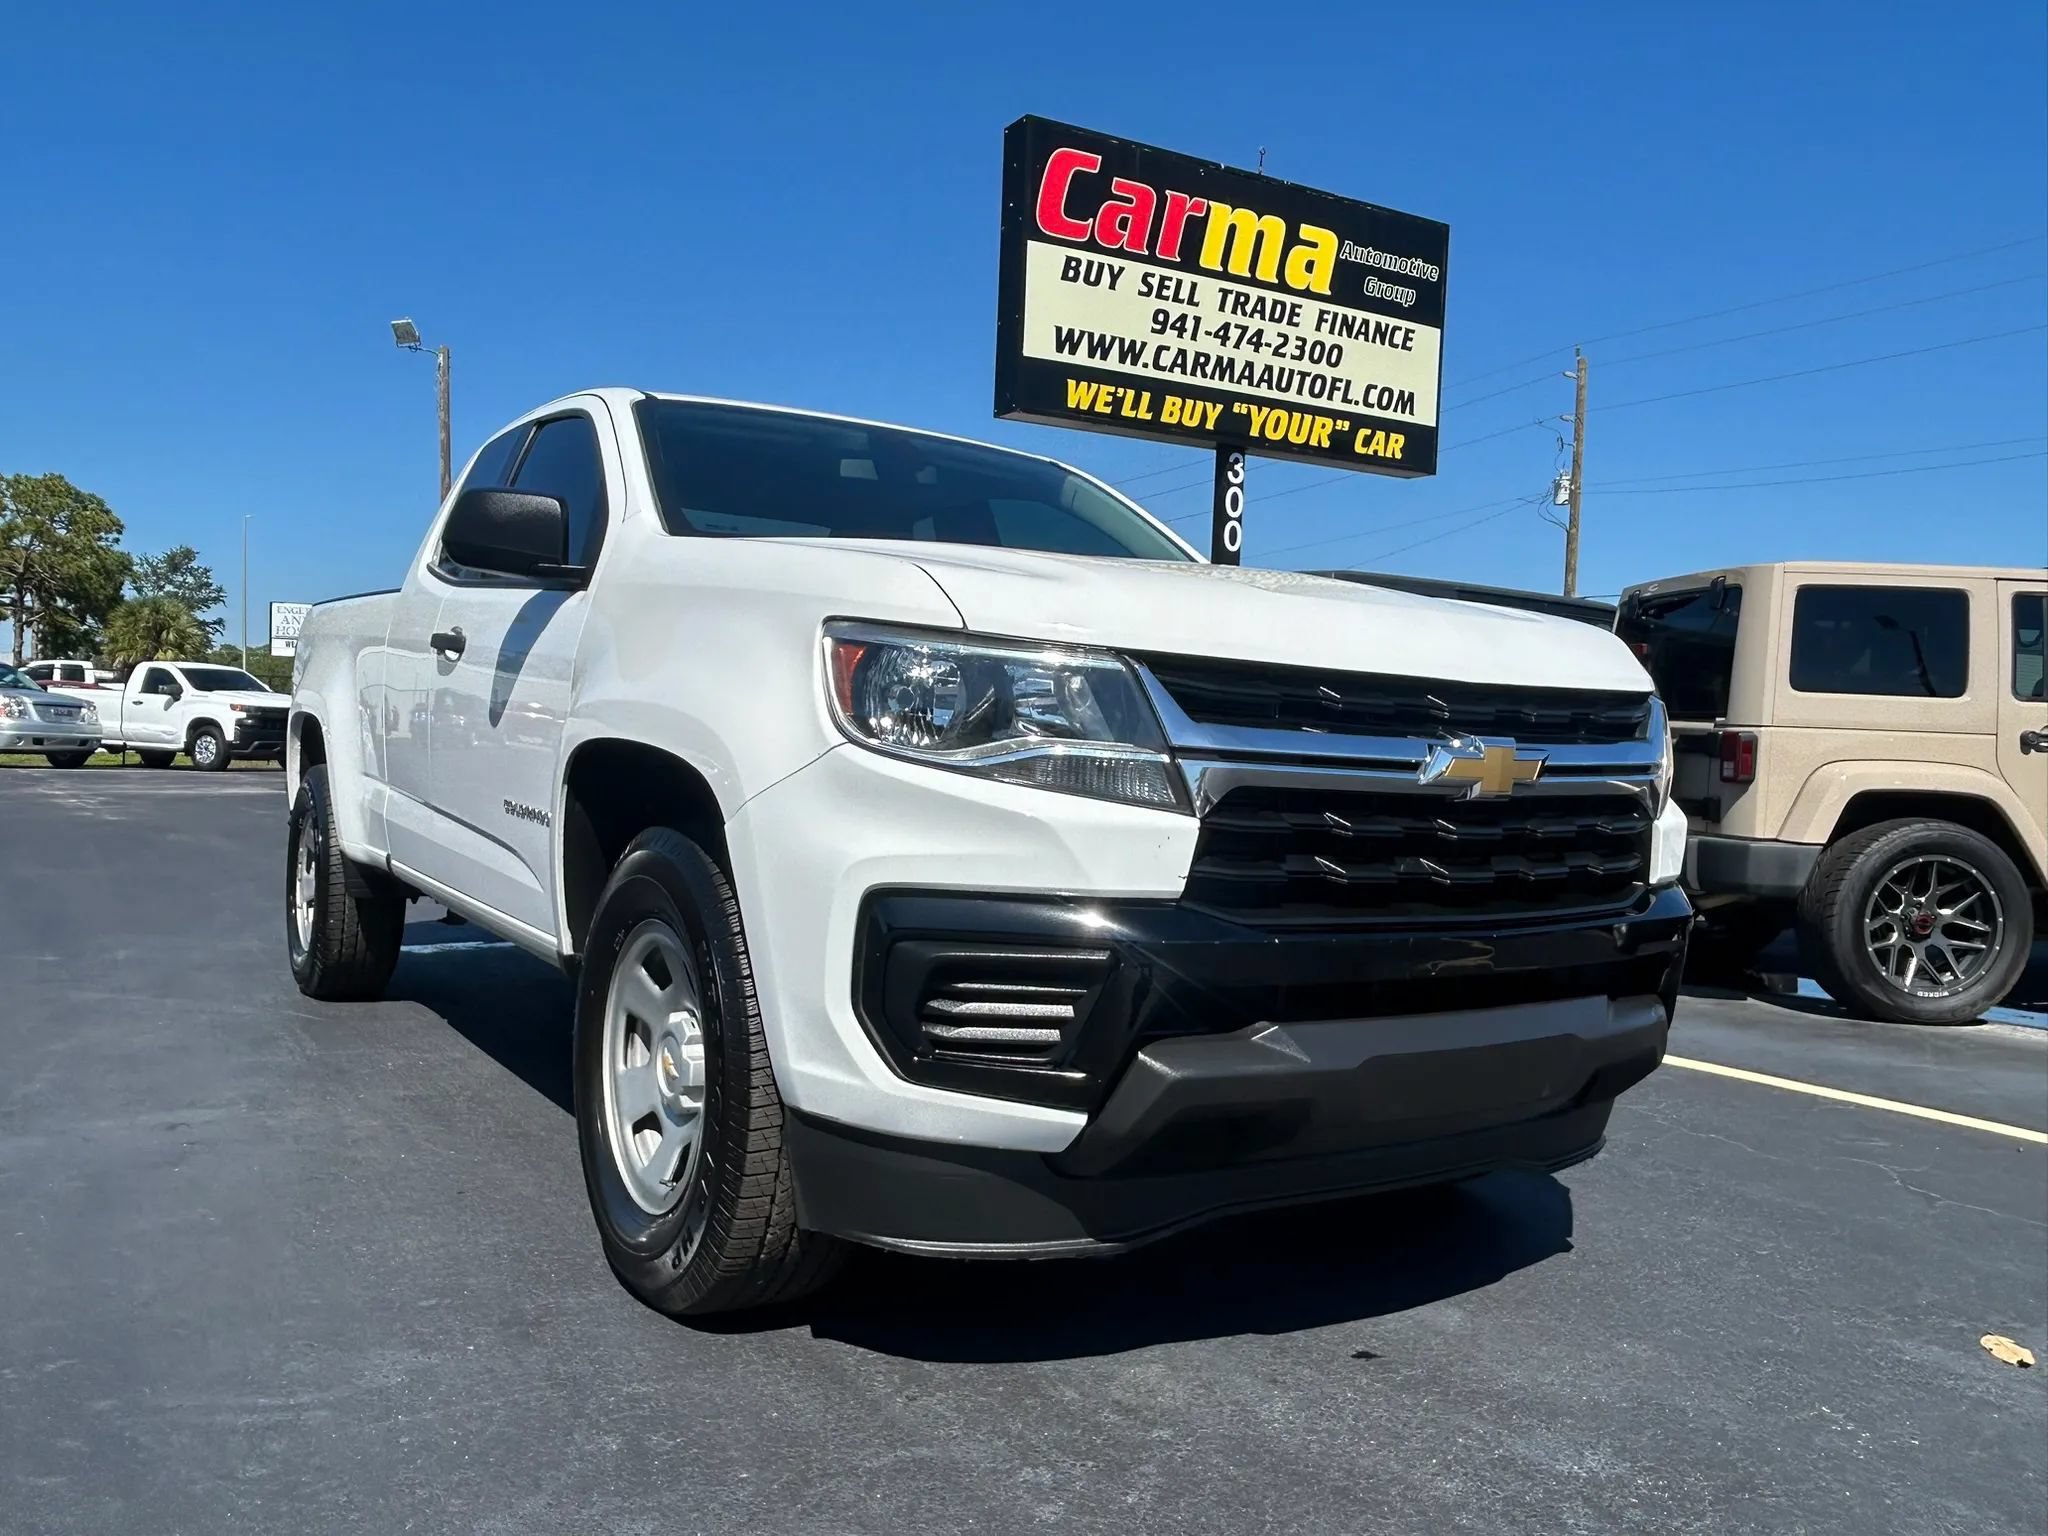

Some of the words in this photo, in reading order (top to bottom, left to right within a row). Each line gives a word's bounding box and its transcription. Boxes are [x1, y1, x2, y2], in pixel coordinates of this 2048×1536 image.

[1036, 147, 1339, 296] Carma
[1340, 240, 1440, 282] Automotive
[1060, 255, 1126, 292] BUY
[1137, 271, 1201, 308] SELL
[1217, 287, 1303, 328] TRADE
[1314, 308, 1416, 352] FINANCE
[1363, 276, 1417, 307] Group
[1054, 325, 1416, 417] WWW.CARMAAUTOFL.COM
[1150, 308, 1344, 368] 941-474-2300
[1066, 378, 1153, 420] WE'LL
[1160, 395, 1224, 431] BUY
[1354, 428, 1406, 460] CAR
[1224, 452, 1245, 552] 300
